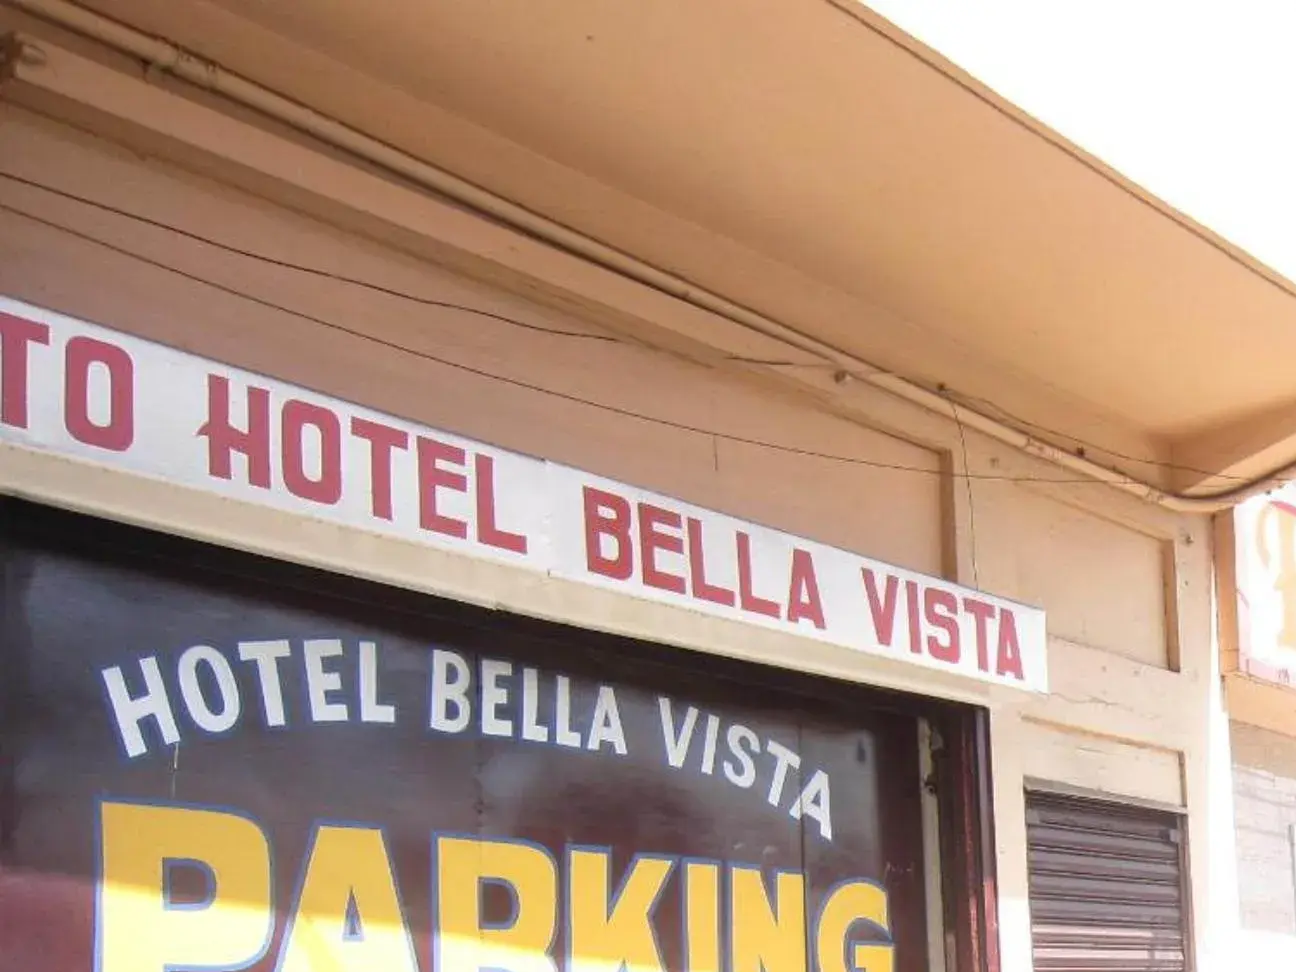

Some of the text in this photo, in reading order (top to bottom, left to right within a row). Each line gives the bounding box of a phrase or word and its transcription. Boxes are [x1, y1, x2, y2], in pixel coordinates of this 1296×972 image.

[199, 375, 527, 554] HOTEL
[583, 486, 825, 630] BELLA
[862, 566, 1024, 680] VISTA
[102, 638, 834, 842] HOTEL BELLA VISTA
